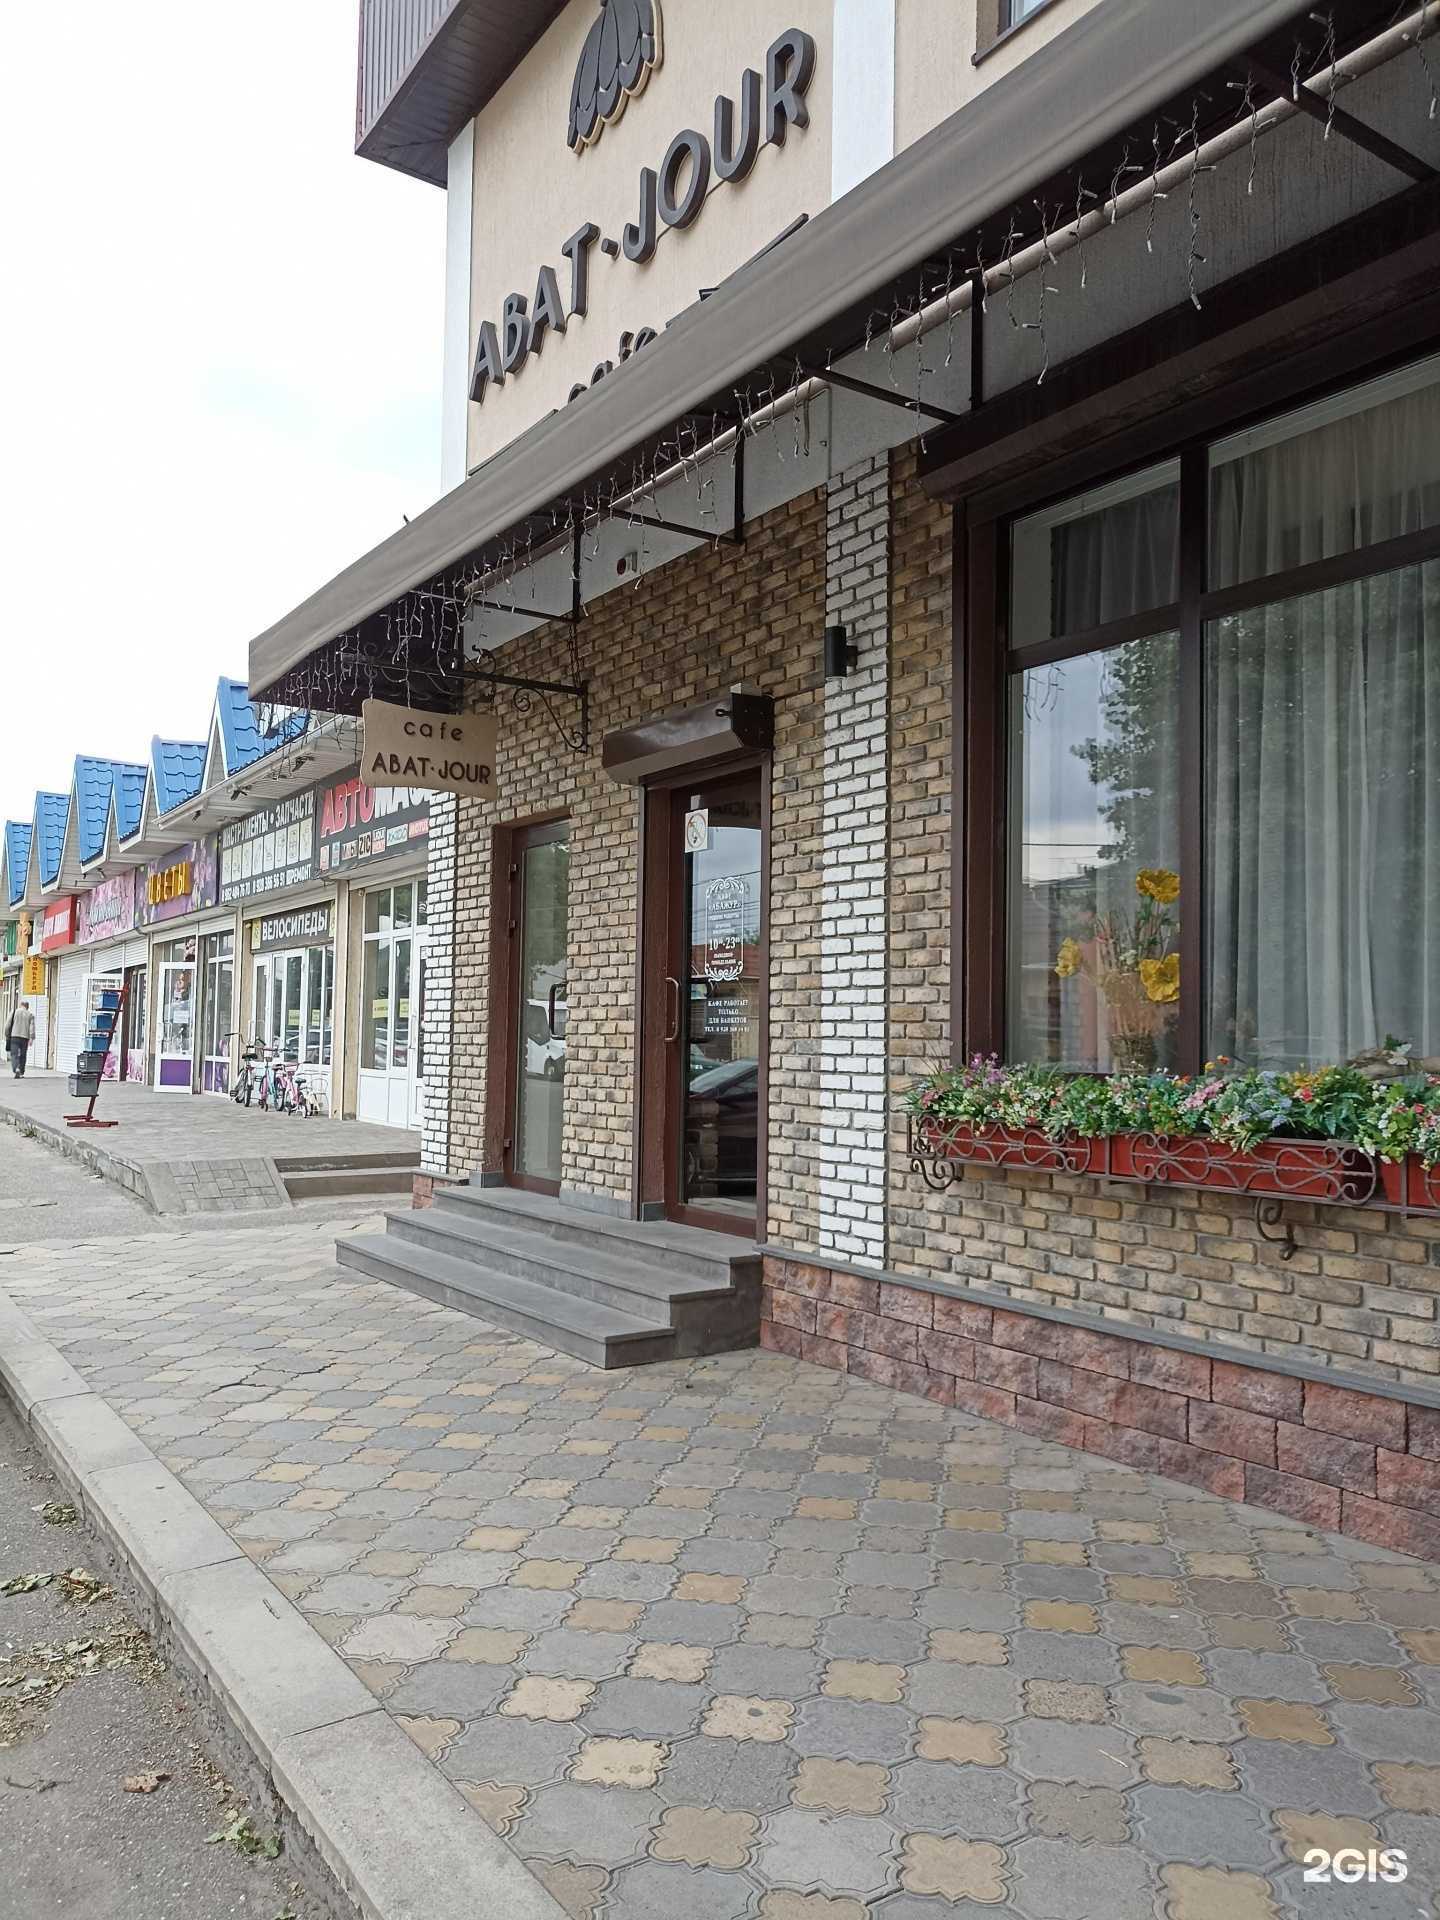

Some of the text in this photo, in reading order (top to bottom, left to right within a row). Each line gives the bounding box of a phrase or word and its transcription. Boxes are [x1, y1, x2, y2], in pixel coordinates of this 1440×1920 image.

[403, 721, 463, 741] cafe
[275, 790, 314, 828] ЗАПЧАСТИ
[148, 861, 190, 906] ЦВЕТЫ
[262, 909, 328, 940] ВЕЛОСИПЕДЫ
